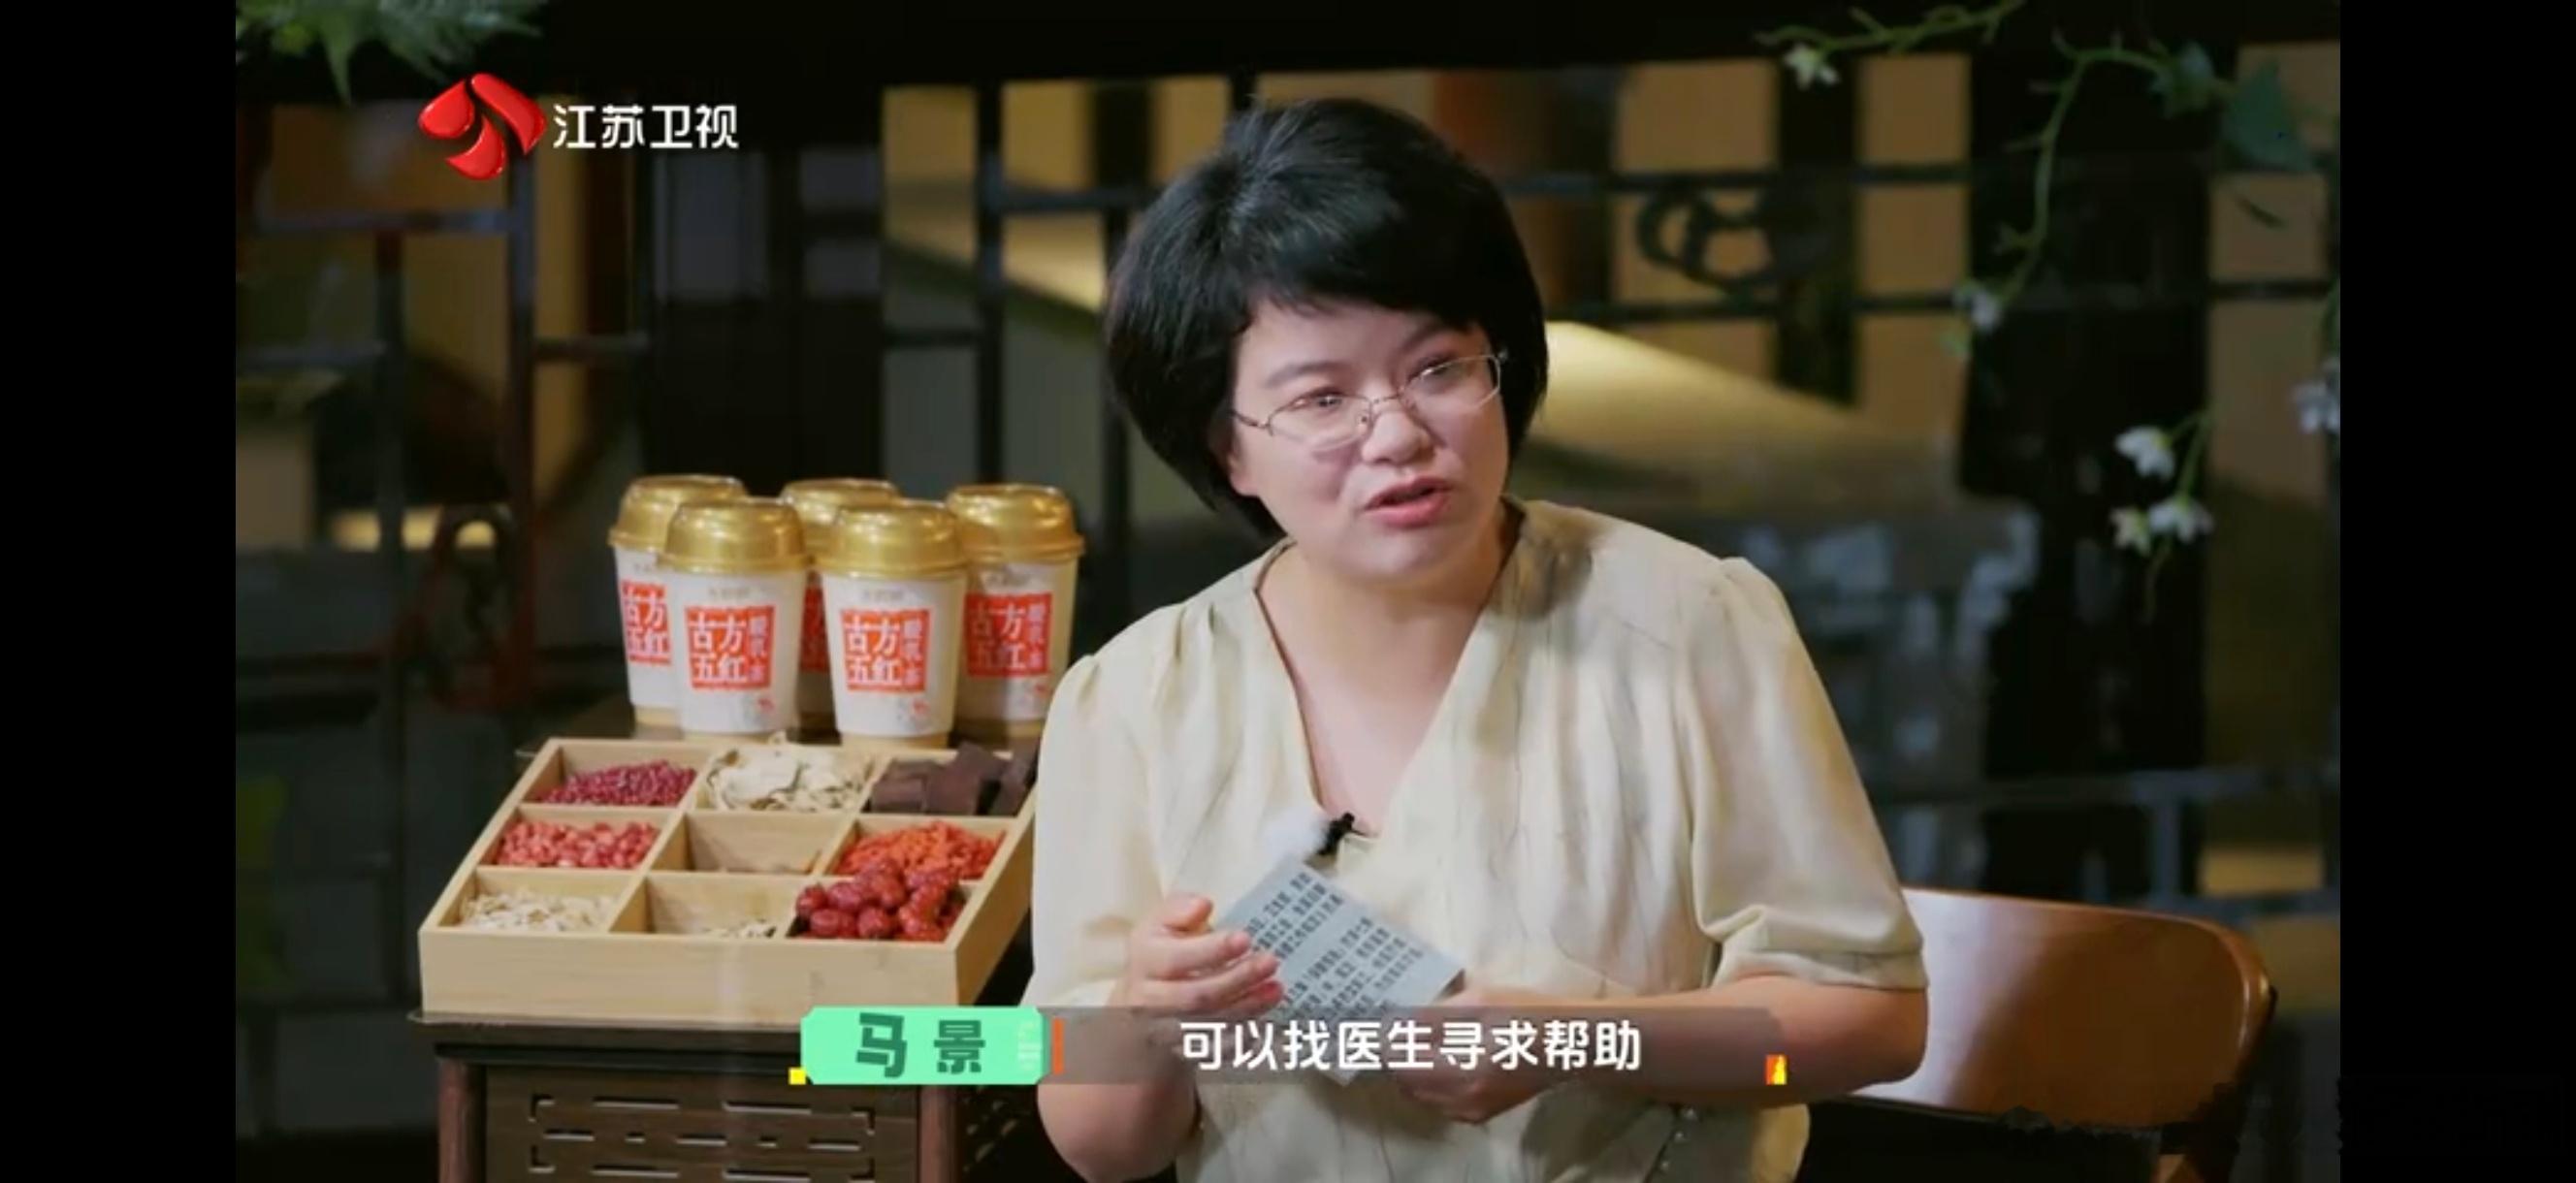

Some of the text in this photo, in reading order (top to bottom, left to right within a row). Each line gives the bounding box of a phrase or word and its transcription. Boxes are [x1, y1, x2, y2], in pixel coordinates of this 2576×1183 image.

[688, 611, 747, 653] 古方
[844, 615, 901, 655] 古方
[969, 601, 1027, 640] 古方
[691, 651, 747, 683] 五红
[846, 655, 903, 686] 五红
